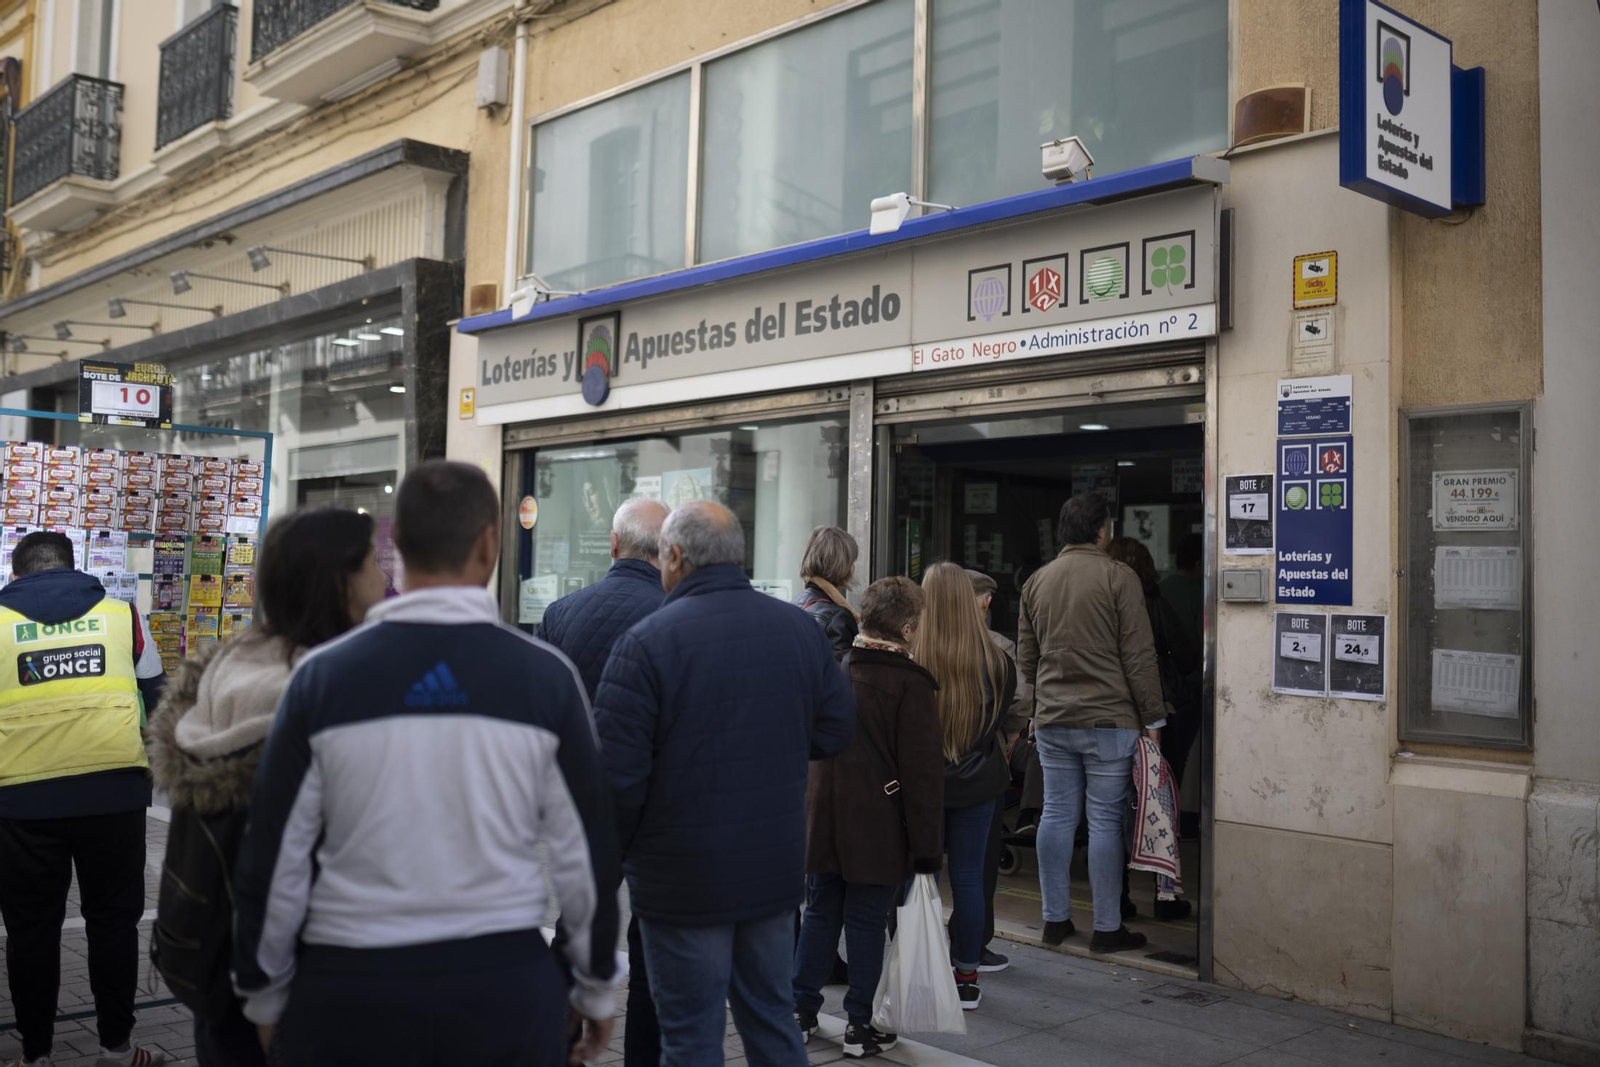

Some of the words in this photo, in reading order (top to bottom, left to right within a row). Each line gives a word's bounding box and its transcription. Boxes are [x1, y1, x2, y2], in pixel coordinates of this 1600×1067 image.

[1377, 113, 1412, 143] Loterías
[1412, 134, 1420, 150] y
[1377, 135, 1418, 164] Apuestas
[1419, 152, 1433, 171] del
[1377, 154, 1409, 180] Estado
[623, 318, 737, 370] Apuestas
[744, 301, 786, 344] del
[794, 285, 901, 336] Estado
[913, 348, 924, 366] El
[931, 344, 965, 364] Gato
[972, 338, 1017, 361] Negro
[1028, 319, 1150, 352] Administración
[1188, 313, 1199, 331] 2
[481, 348, 557, 387] Loterías
[562, 349, 576, 382] y
[83, 372, 108, 381] BOTE
[120, 387, 151, 405] 10
[1239, 479, 1257, 490] BOTE
[1443, 478, 1469, 486] GRAN
[1472, 477, 1507, 486] PREMIO
[1450, 488, 1492, 498] 44.199
[1241, 503, 1256, 513] 17
[1482, 513, 1504, 523] AQUÍ
[1278, 550, 1323, 563] Loterías
[1323, 552, 1332, 565] y
[1278, 568, 1330, 583] Apuestas
[1331, 568, 1349, 580] del
[1278, 586, 1316, 598] Estado
[42, 619, 100, 636] ONCE
[1291, 618, 1310, 629] BOTE
[1347, 619, 1367, 631] BOTE
[1292, 641, 1306, 653] 2,1
[1344, 643, 1369, 656] 24,5
[43, 653, 72, 664] grupo
[74, 647, 101, 658] social
[43, 658, 101, 678] ONCE
